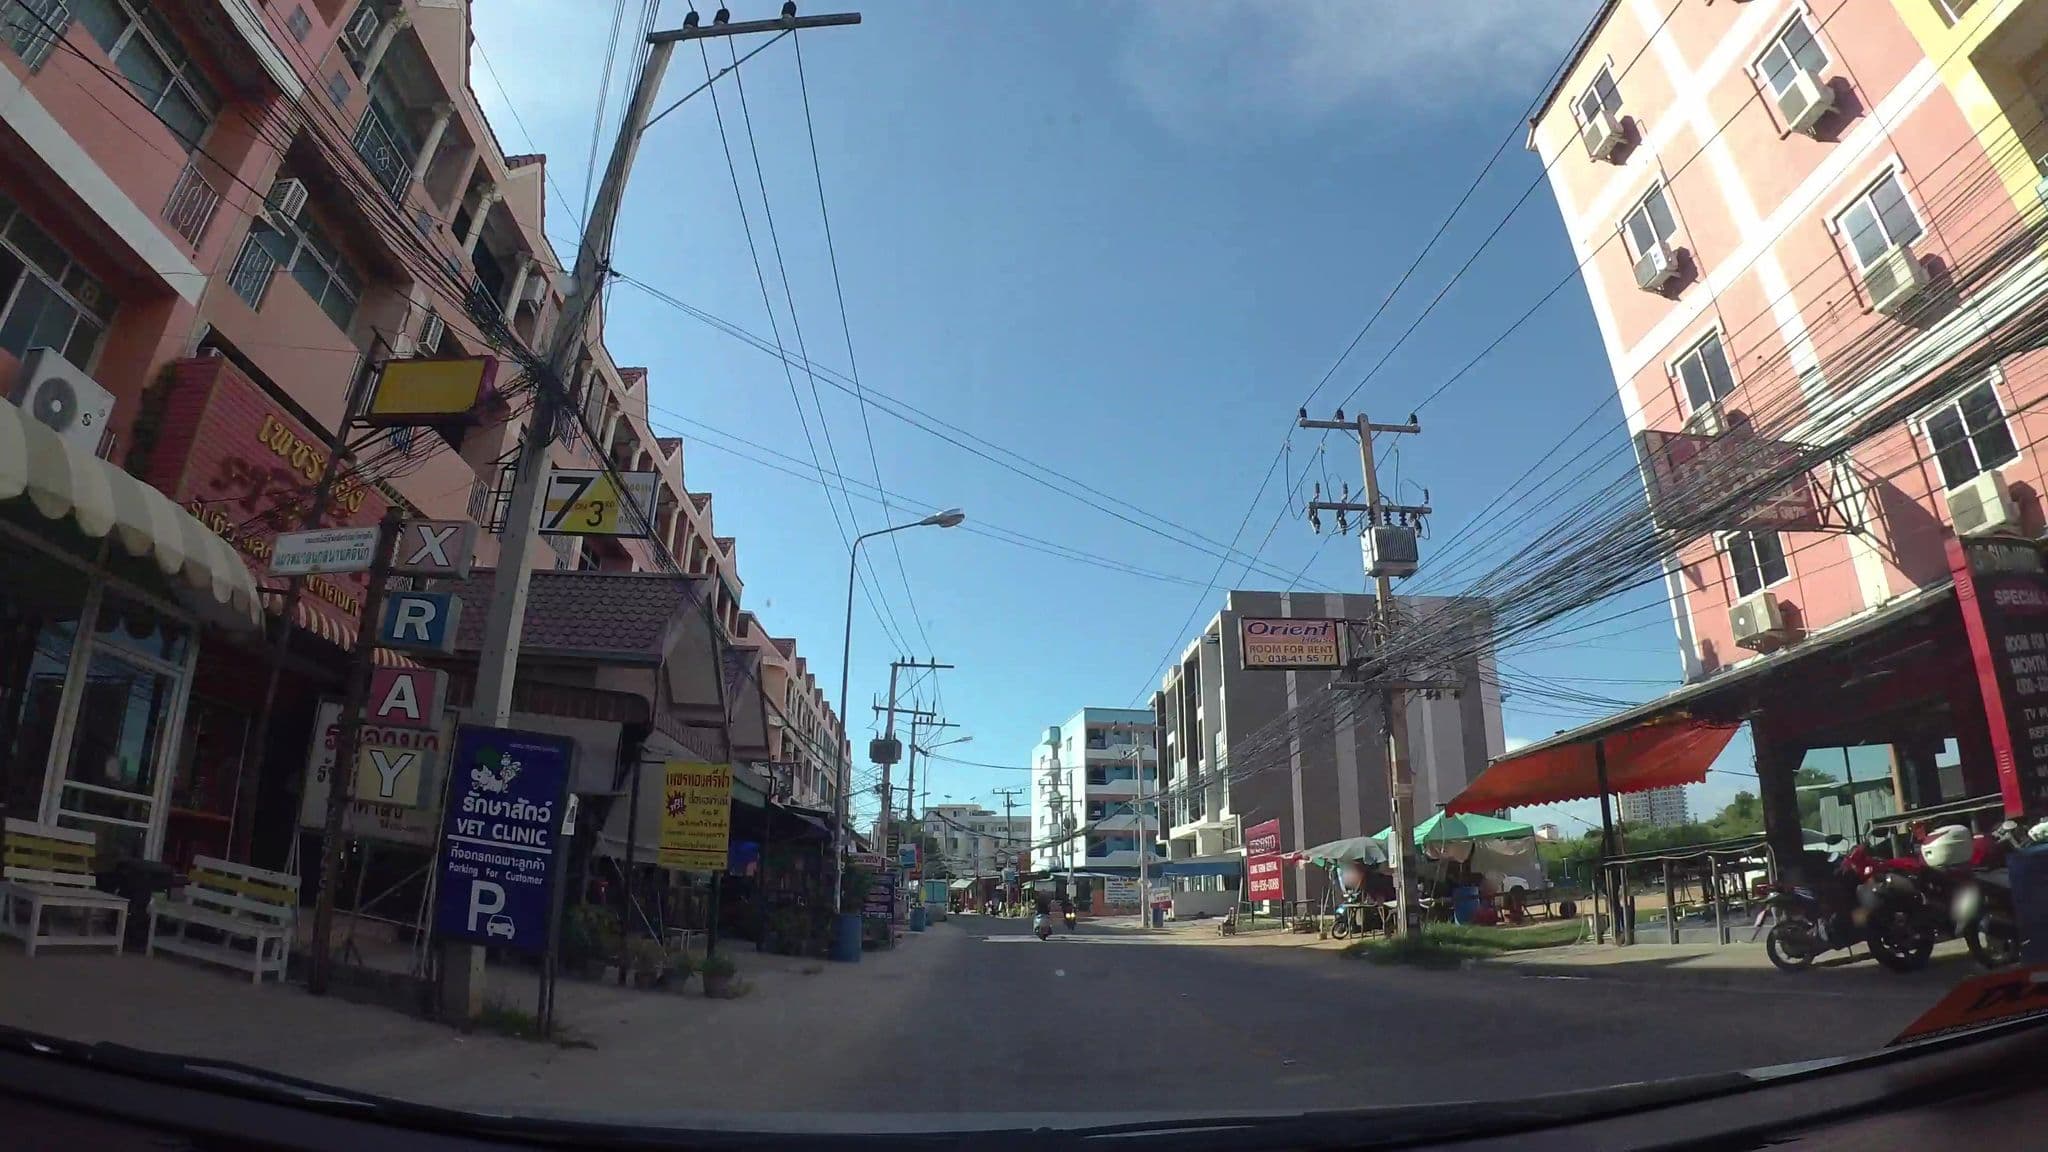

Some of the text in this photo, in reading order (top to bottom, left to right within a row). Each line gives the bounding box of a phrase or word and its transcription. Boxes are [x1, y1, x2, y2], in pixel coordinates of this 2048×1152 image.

[547, 476, 595, 528] 7
[586, 500, 604, 527] 3
[406, 525, 459, 567] X
[392, 598, 437, 641] R
[1247, 620, 1333, 636] Orient
[1249, 644, 1333, 654] ROOM FOR RENT
[1307, 655, 1319, 663] 55
[377, 673, 421, 719] A
[370, 749, 416, 797] Y
[462, 790, 553, 824] รักษาสัตว์
[457, 818, 548, 846] VET CLINIC
[449, 862, 543, 885] Parking For Customer
[450, 842, 545, 872] ที่จอดรถเฉพาะลูกค้า
[467, 879, 506, 932] P
